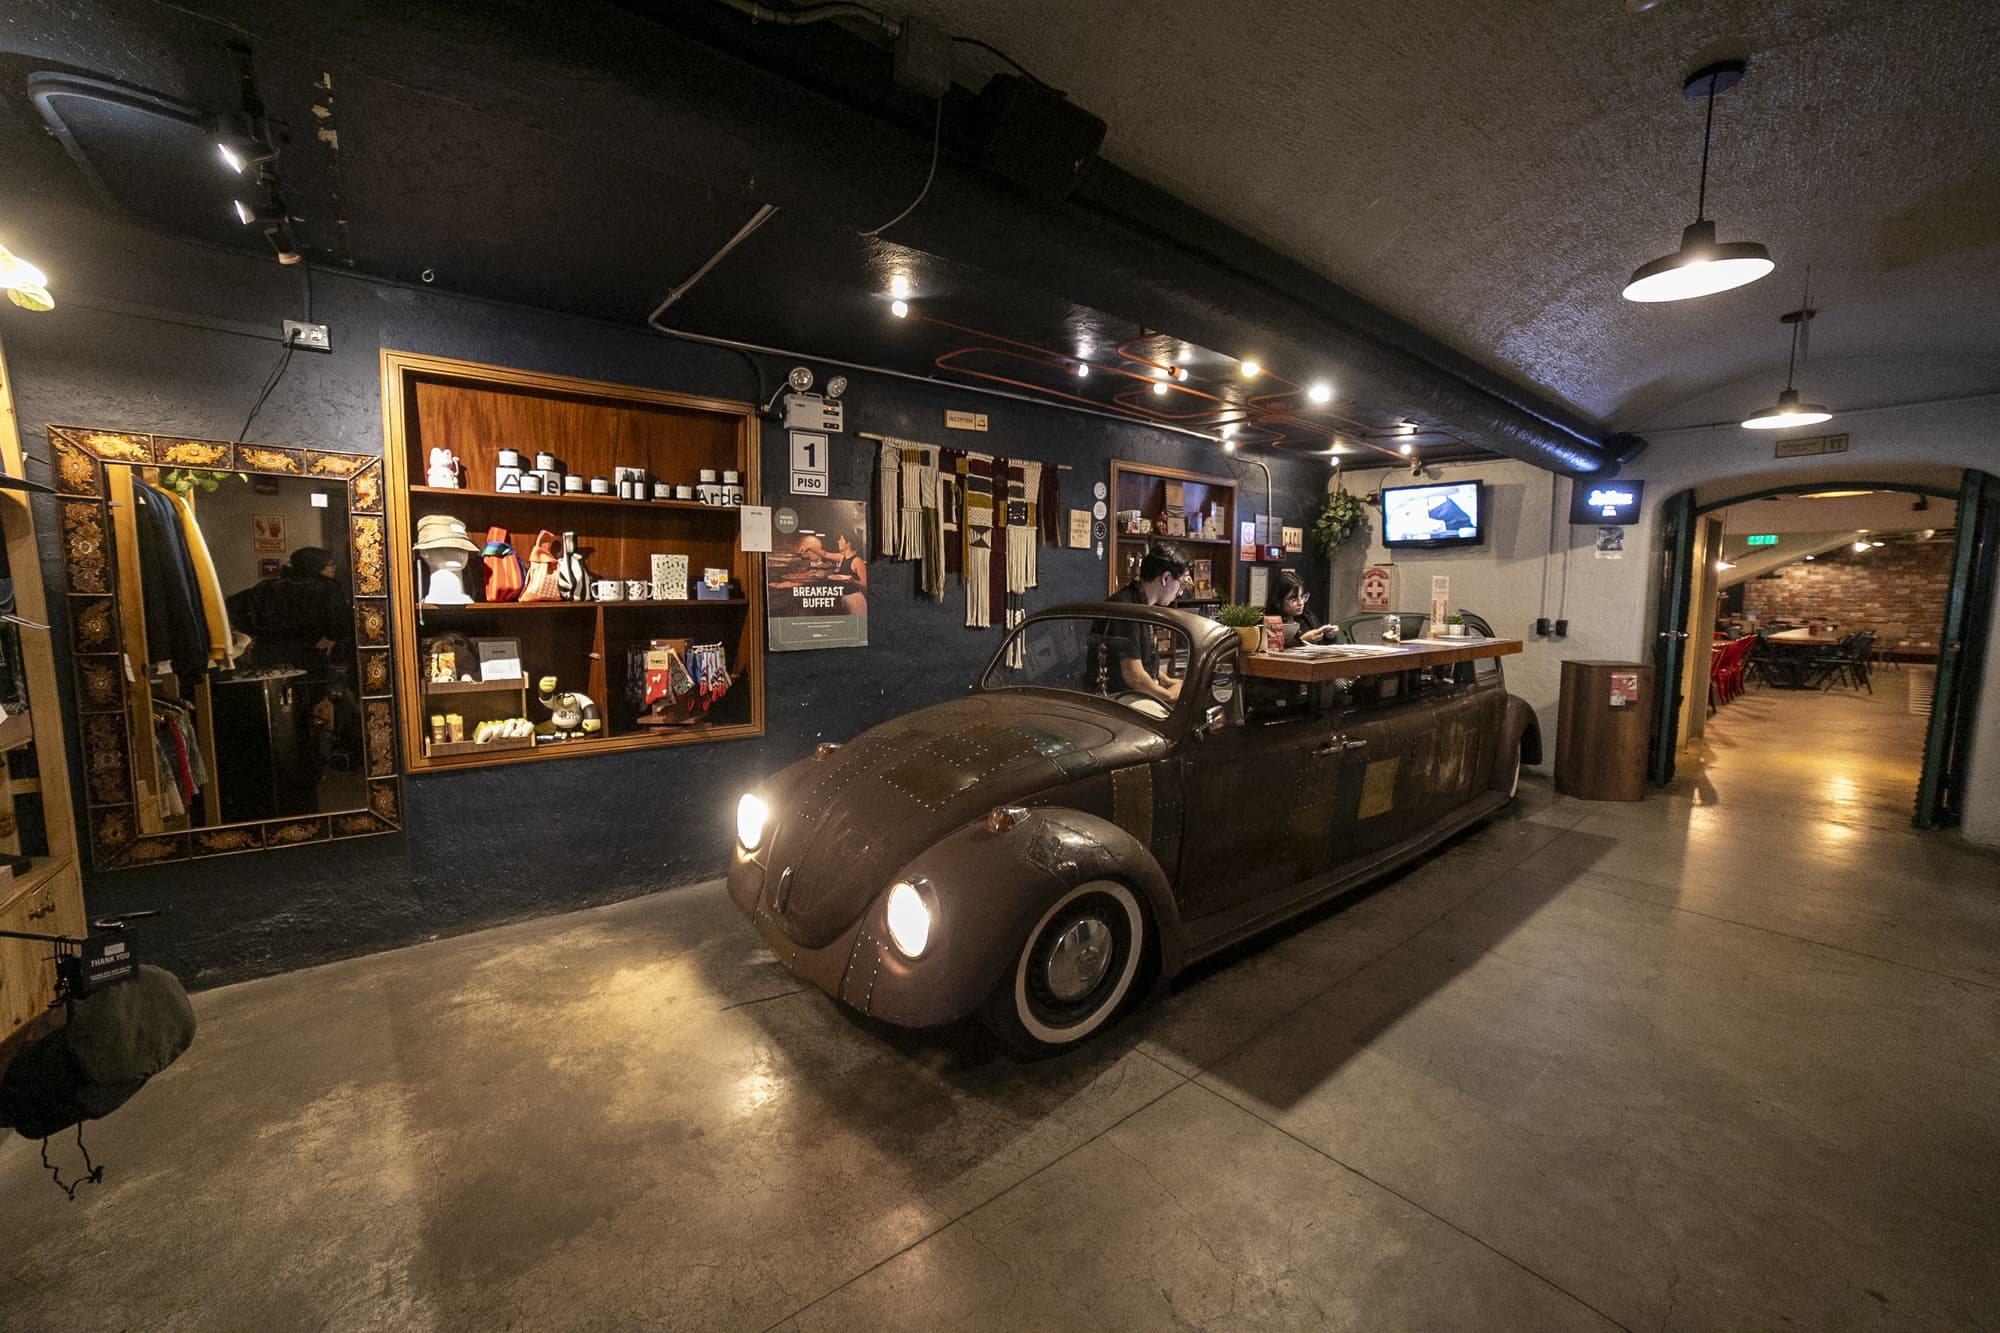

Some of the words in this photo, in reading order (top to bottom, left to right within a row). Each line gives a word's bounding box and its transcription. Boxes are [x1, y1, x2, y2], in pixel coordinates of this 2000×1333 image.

[803, 443, 816, 467] 1
[797, 478, 821, 488] PISO
[698, 488, 743, 506] Arde
[793, 586, 844, 597] BREAKFAST
[802, 597, 835, 608] BUFFET
[91, 956, 115, 967] THANK
[116, 952, 130, 960] YOU
